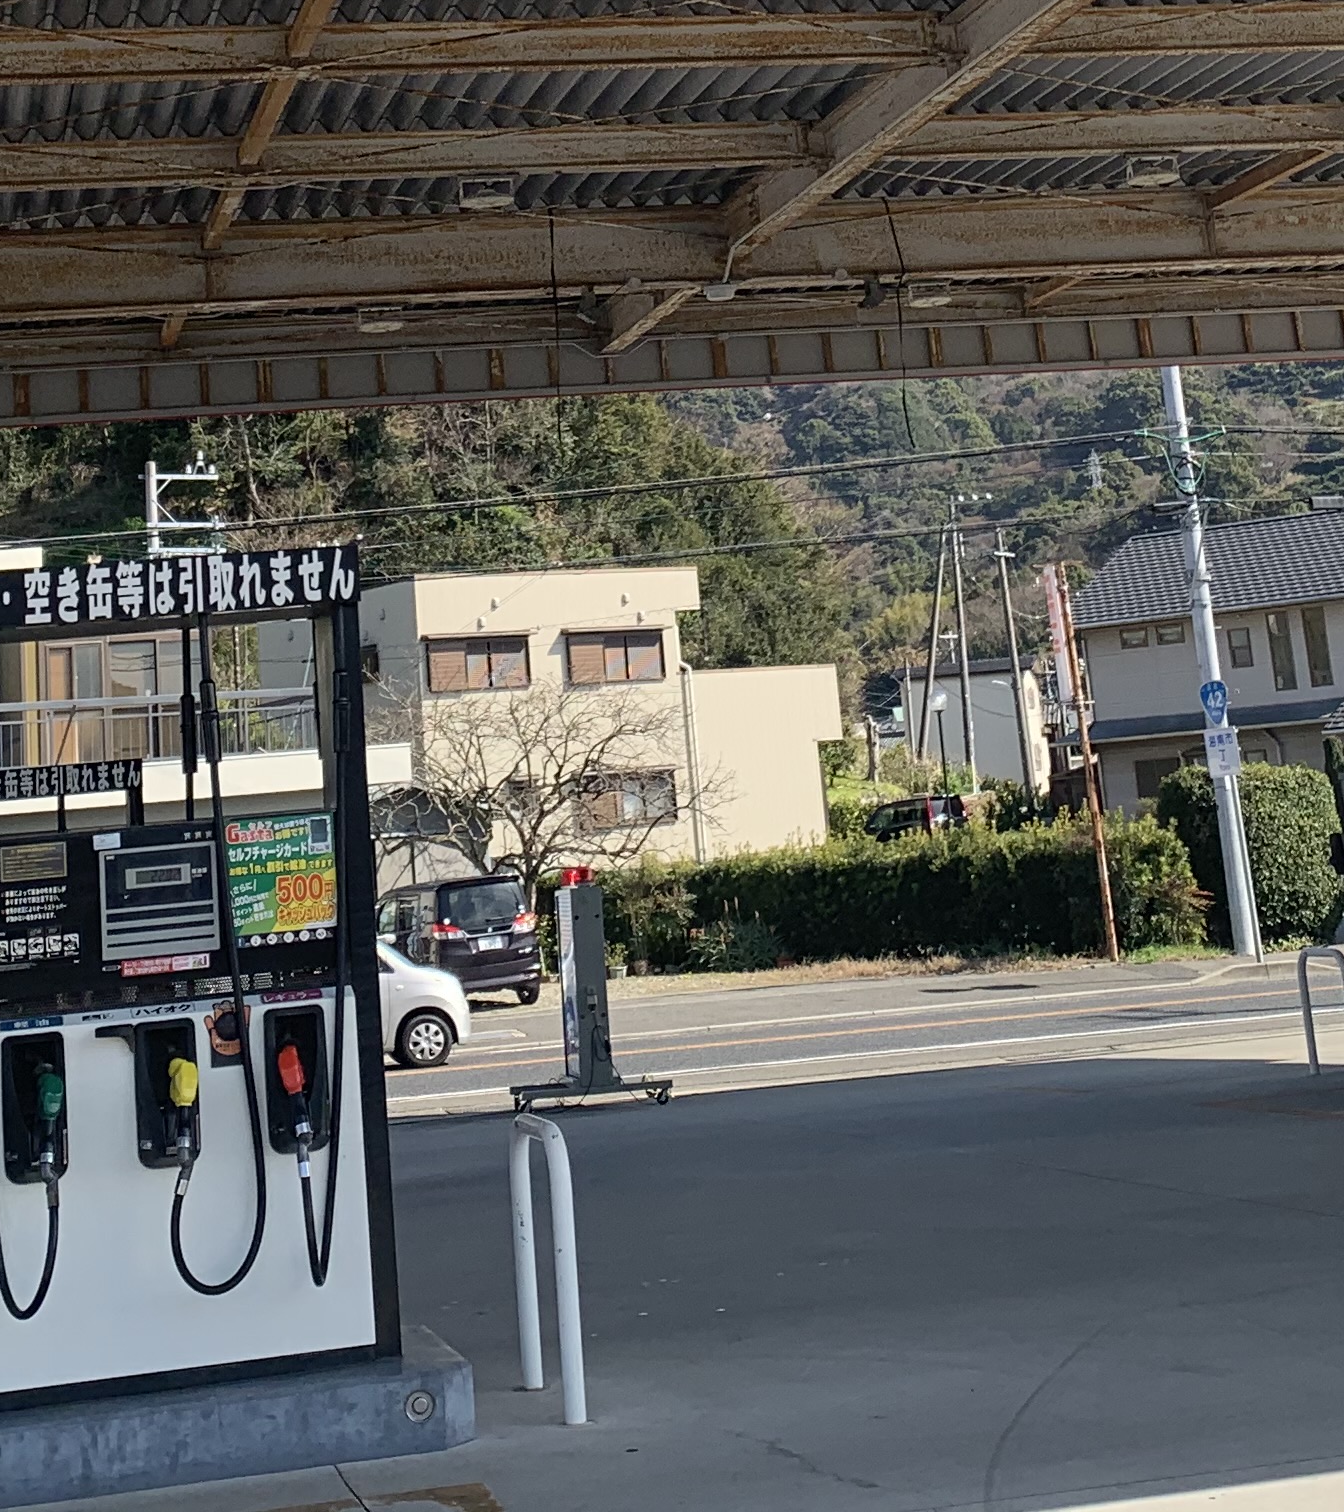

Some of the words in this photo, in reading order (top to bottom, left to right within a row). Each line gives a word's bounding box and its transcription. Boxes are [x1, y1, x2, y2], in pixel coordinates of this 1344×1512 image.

[1207, 691, 1223, 708] 42
[226, 823, 274, 844] Gasta
[228, 841, 308, 862] セルフチャージカード
[263, 991, 320, 1003] レギュラー
[136, 1004, 191, 1016] ハイオク
